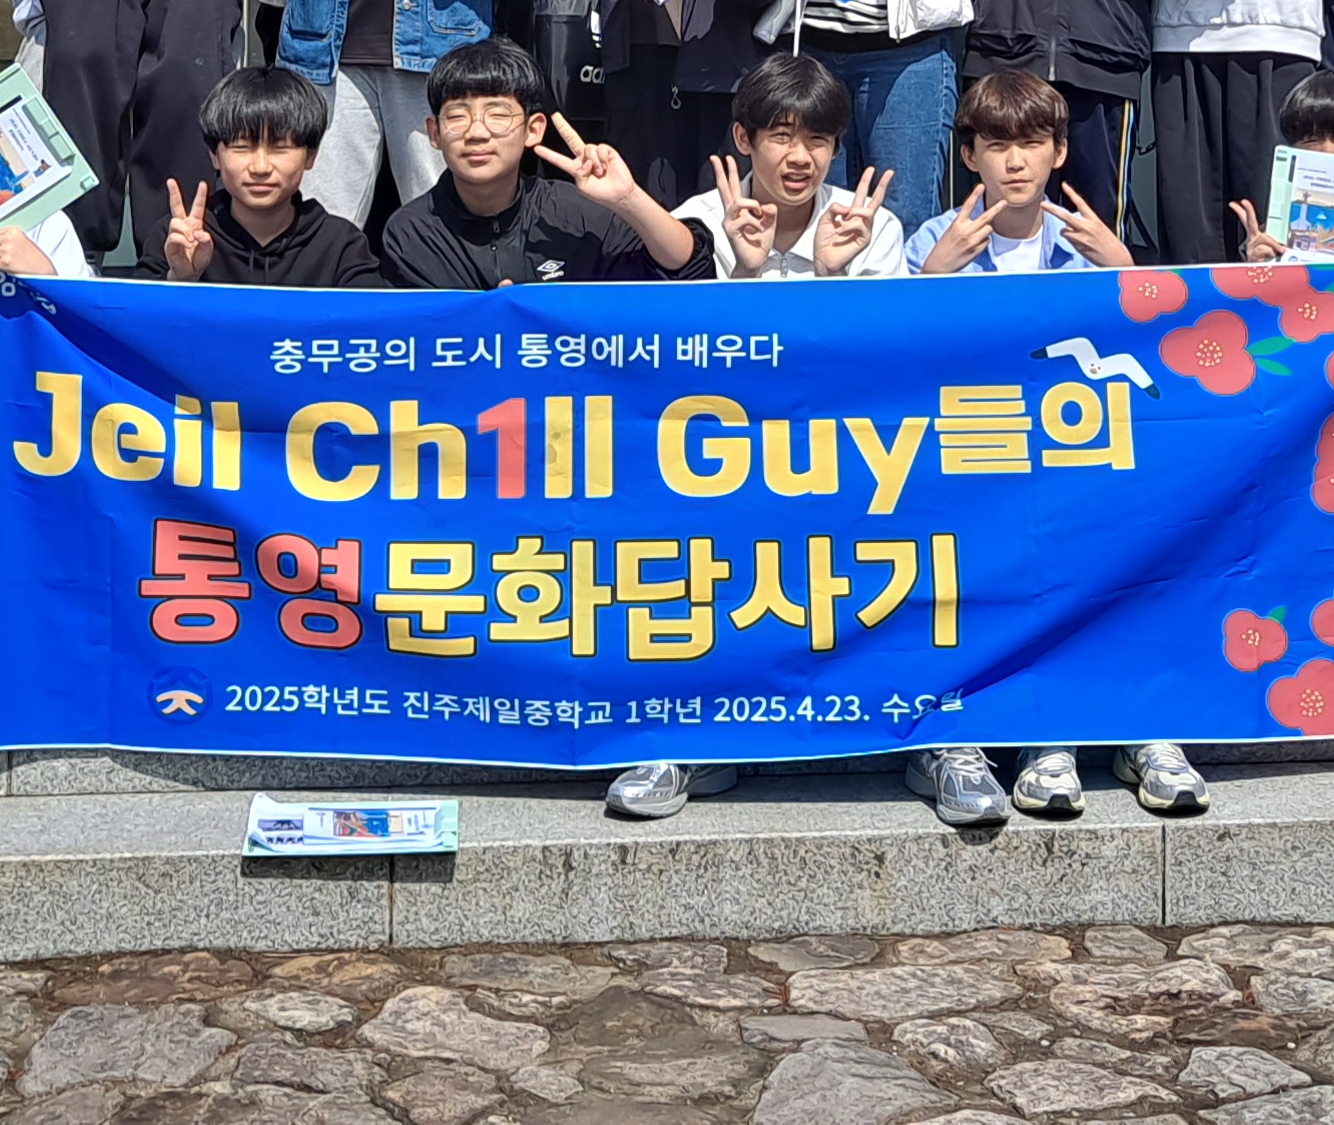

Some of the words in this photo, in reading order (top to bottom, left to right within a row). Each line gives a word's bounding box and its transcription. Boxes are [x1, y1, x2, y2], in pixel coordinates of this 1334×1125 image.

[269, 336, 415, 374] 충무공의
[431, 333, 502, 369] 도시
[517, 333, 660, 369] 통영에서
[676, 333, 784, 369] 배우다
[13, 371, 241, 491] Jeil
[654, 381, 1136, 515] Guy들의
[139, 518, 960, 661] 통영문화답사기
[225, 684, 391, 716] 2025학년도
[403, 691, 613, 730] 진주제일중학교
[625, 696, 702, 724] 1학년
[713, 695, 870, 722] 2025.4.23.
